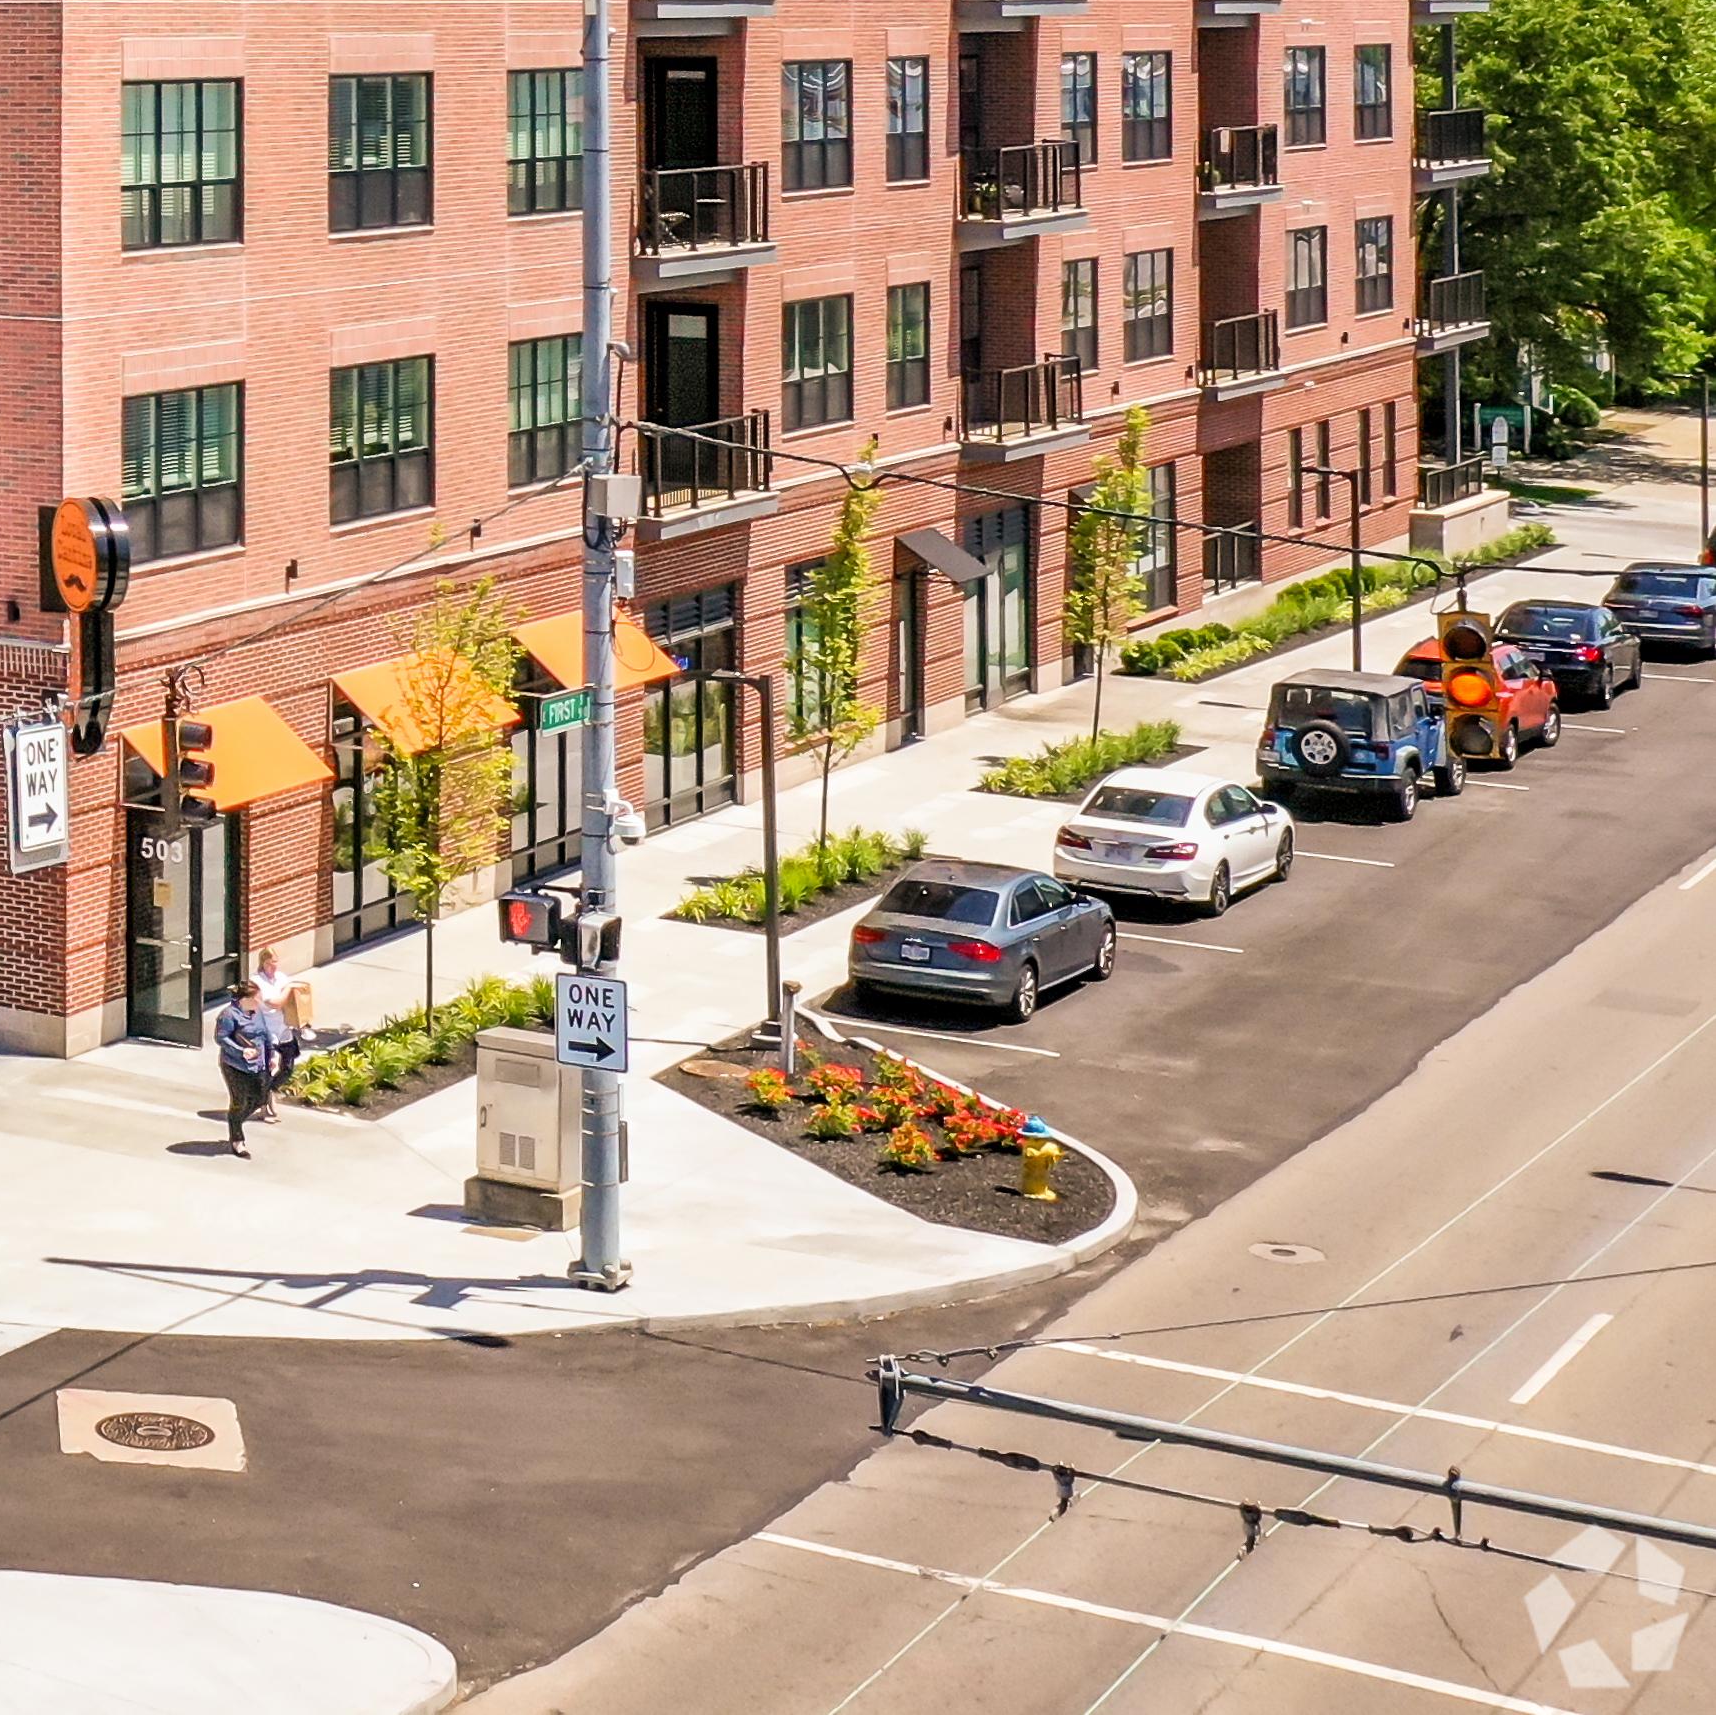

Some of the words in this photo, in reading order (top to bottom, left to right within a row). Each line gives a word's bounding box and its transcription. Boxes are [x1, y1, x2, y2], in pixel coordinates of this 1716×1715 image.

[27, 737, 56, 766] ONE
[26, 768, 57, 797] WAY
[141, 837, 183, 863] 503
[569, 983, 616, 1009] ONE
[567, 1008, 617, 1033] WAY
